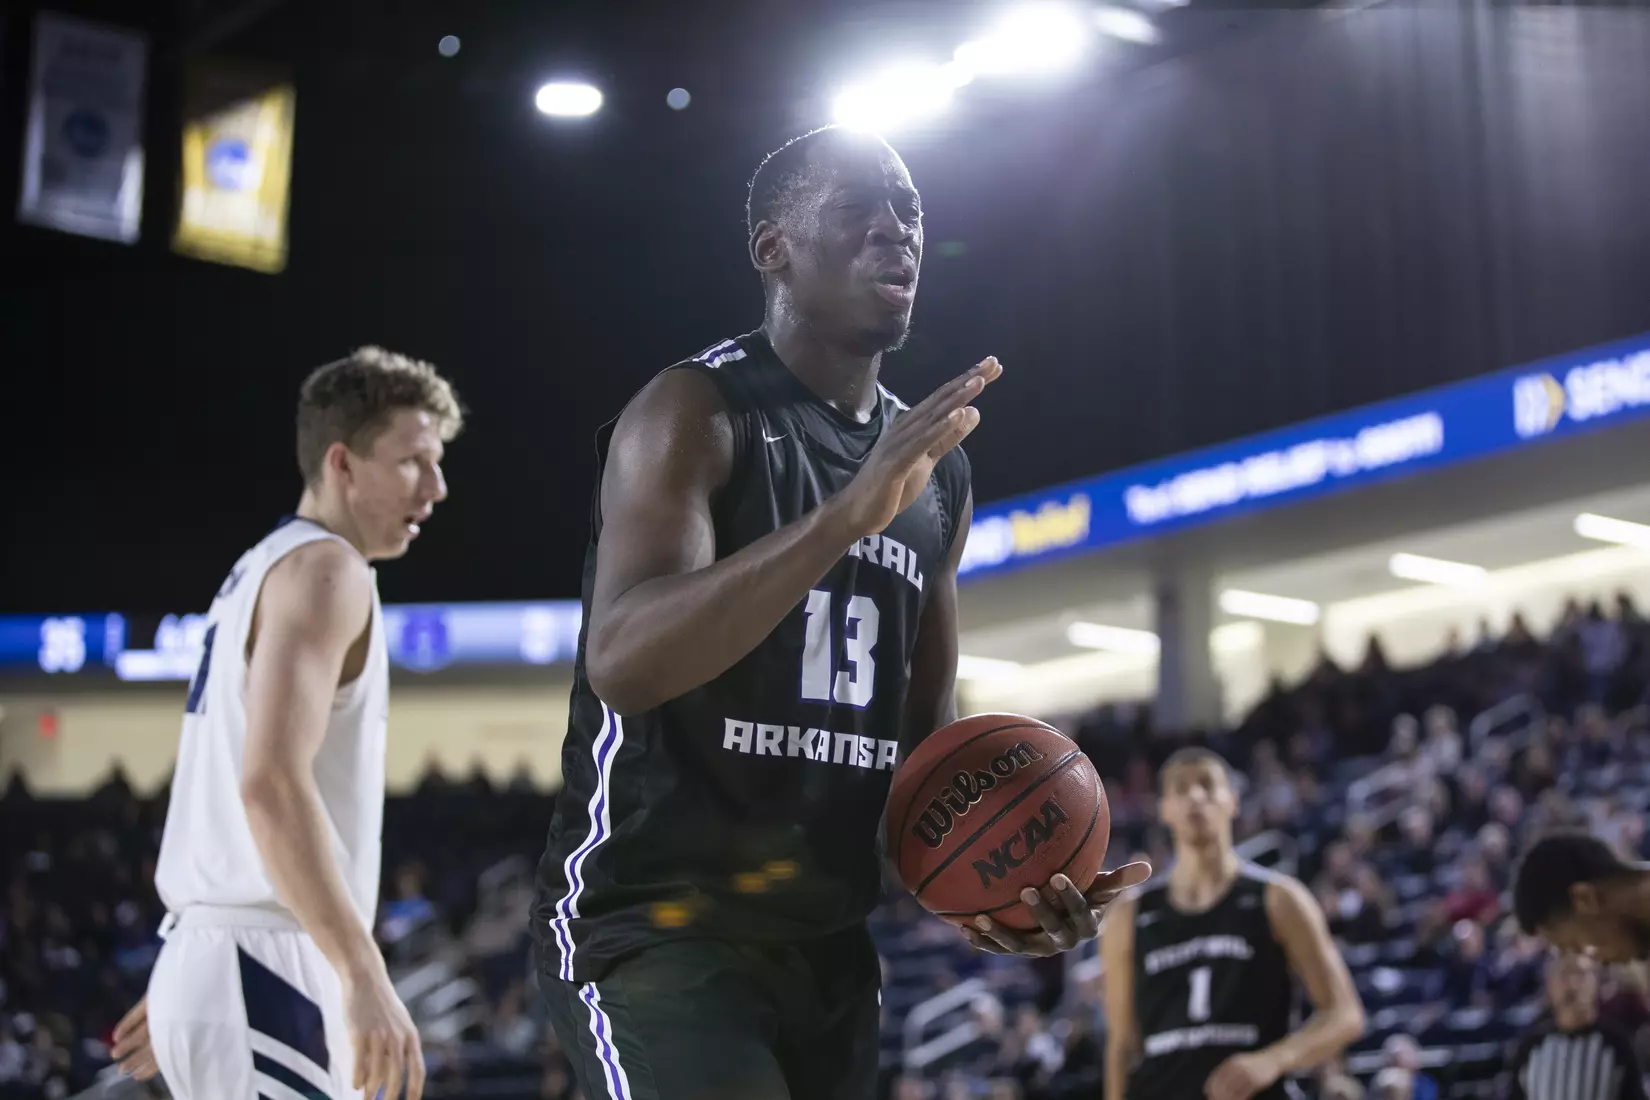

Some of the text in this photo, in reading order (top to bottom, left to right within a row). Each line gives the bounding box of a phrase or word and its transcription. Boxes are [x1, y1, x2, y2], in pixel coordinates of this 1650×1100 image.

[799, 587, 881, 709] 13
[722, 717, 899, 771] ARKANSA
[912, 741, 1044, 849] Wilson
[972, 796, 1070, 889] NCAA
[1187, 965, 1213, 1022] 1
